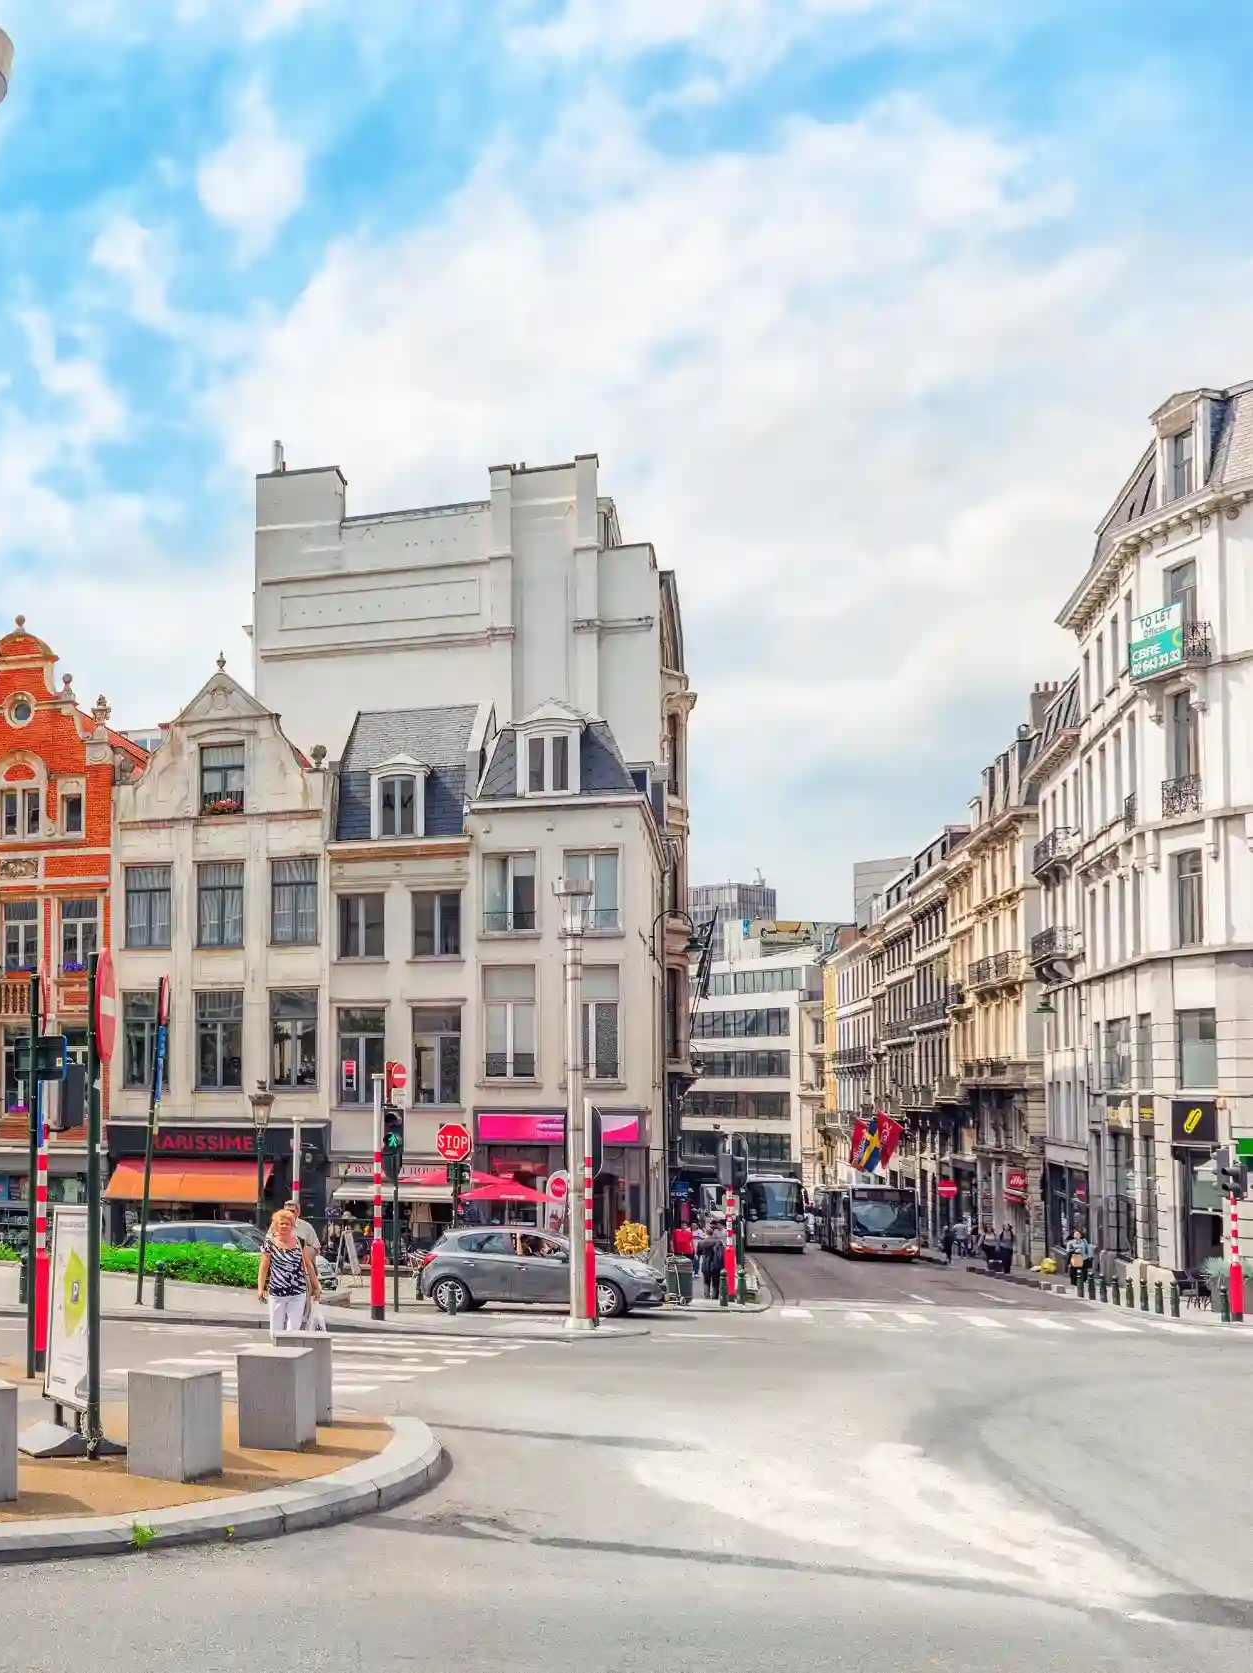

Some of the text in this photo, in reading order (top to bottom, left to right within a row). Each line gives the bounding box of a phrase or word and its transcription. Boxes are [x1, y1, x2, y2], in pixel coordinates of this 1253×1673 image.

[1139, 608, 1172, 629] TO LET
[1132, 643, 1161, 661] CBRE
[438, 1134, 468, 1149] STOP
